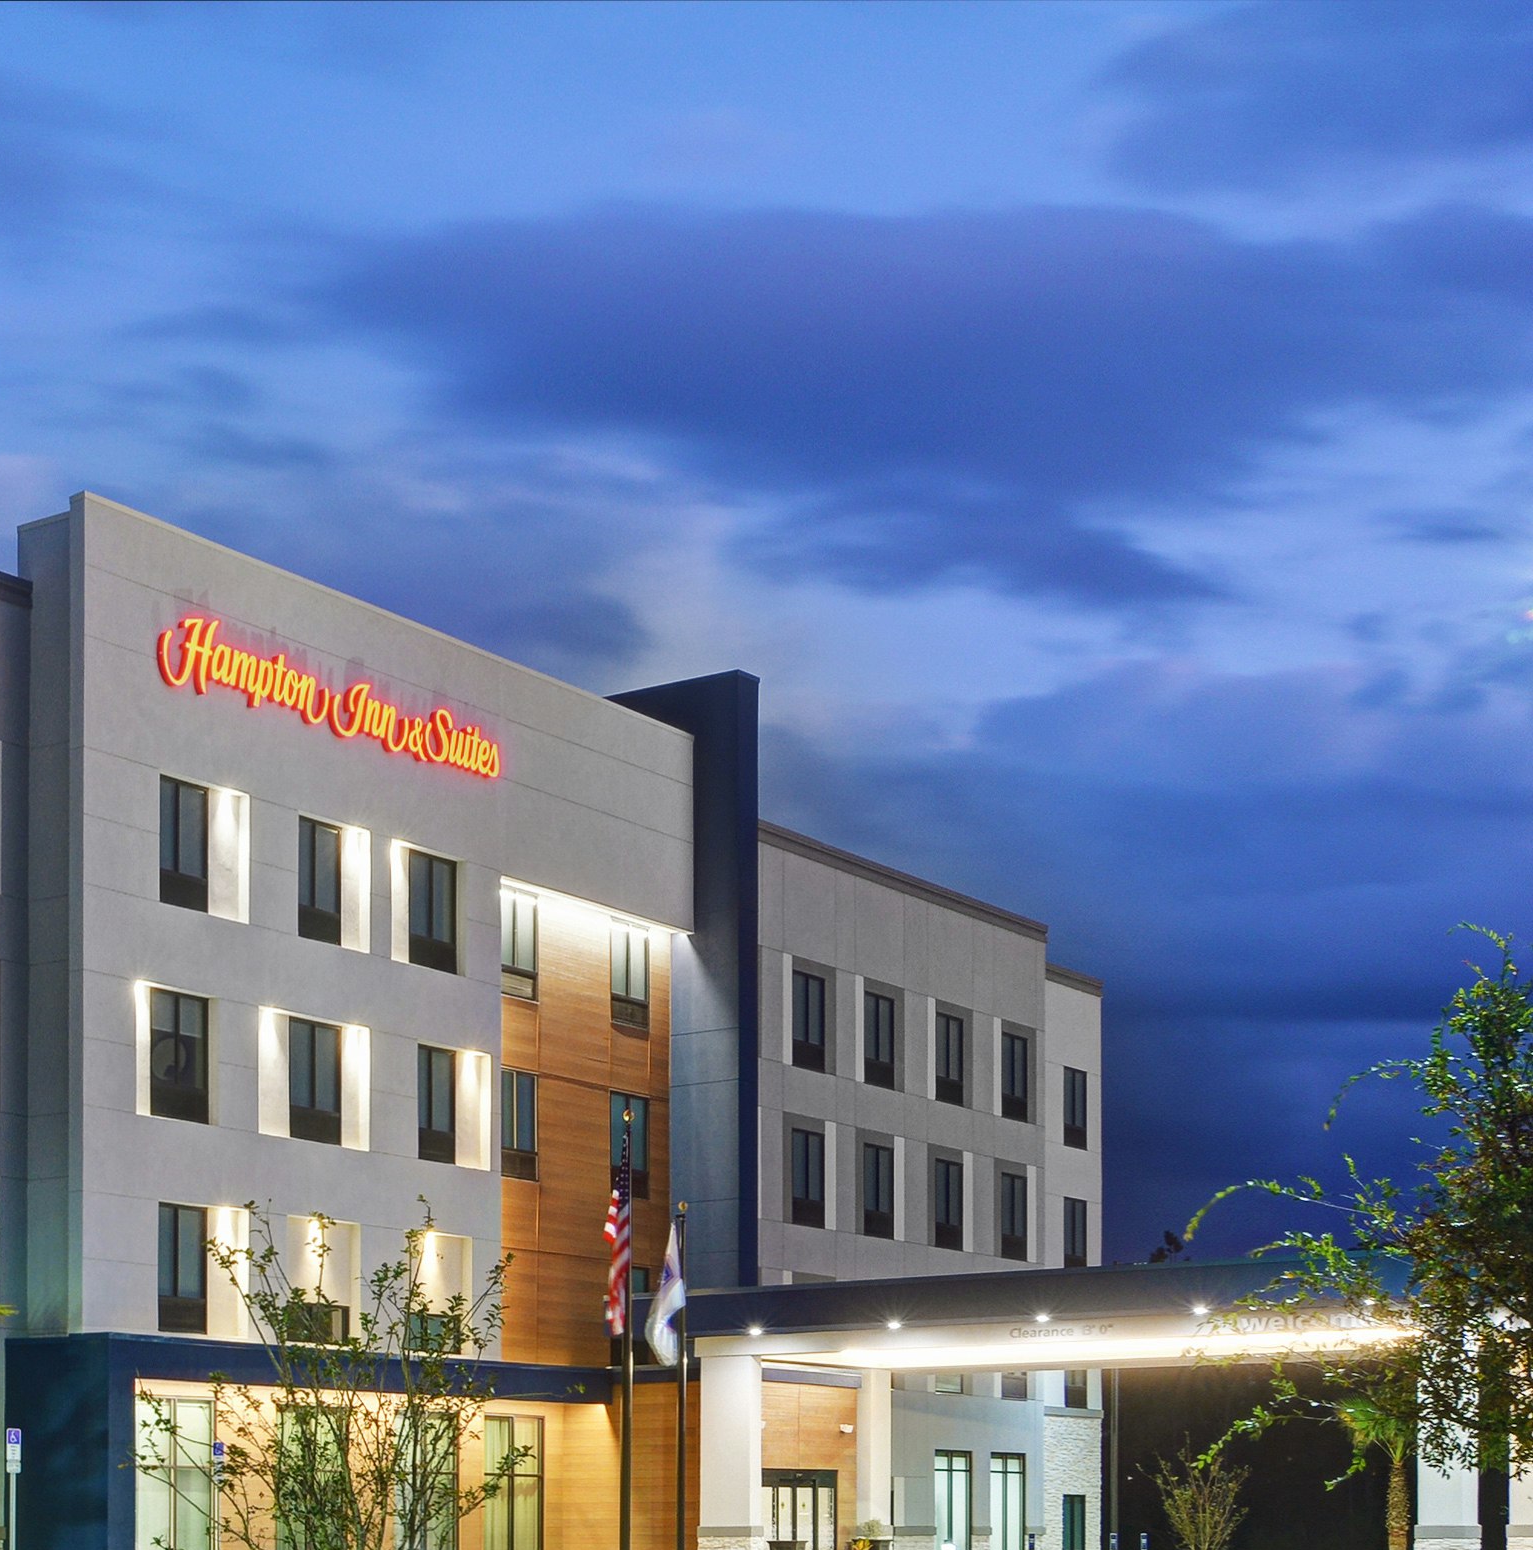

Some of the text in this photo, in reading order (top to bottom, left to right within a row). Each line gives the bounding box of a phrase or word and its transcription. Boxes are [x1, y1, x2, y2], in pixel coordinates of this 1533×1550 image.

[157, 617, 501, 778] Hampton Inn & Suites
[1009, 1327, 1074, 1338] Clearance
[1237, 1313, 1376, 1333] welcm
